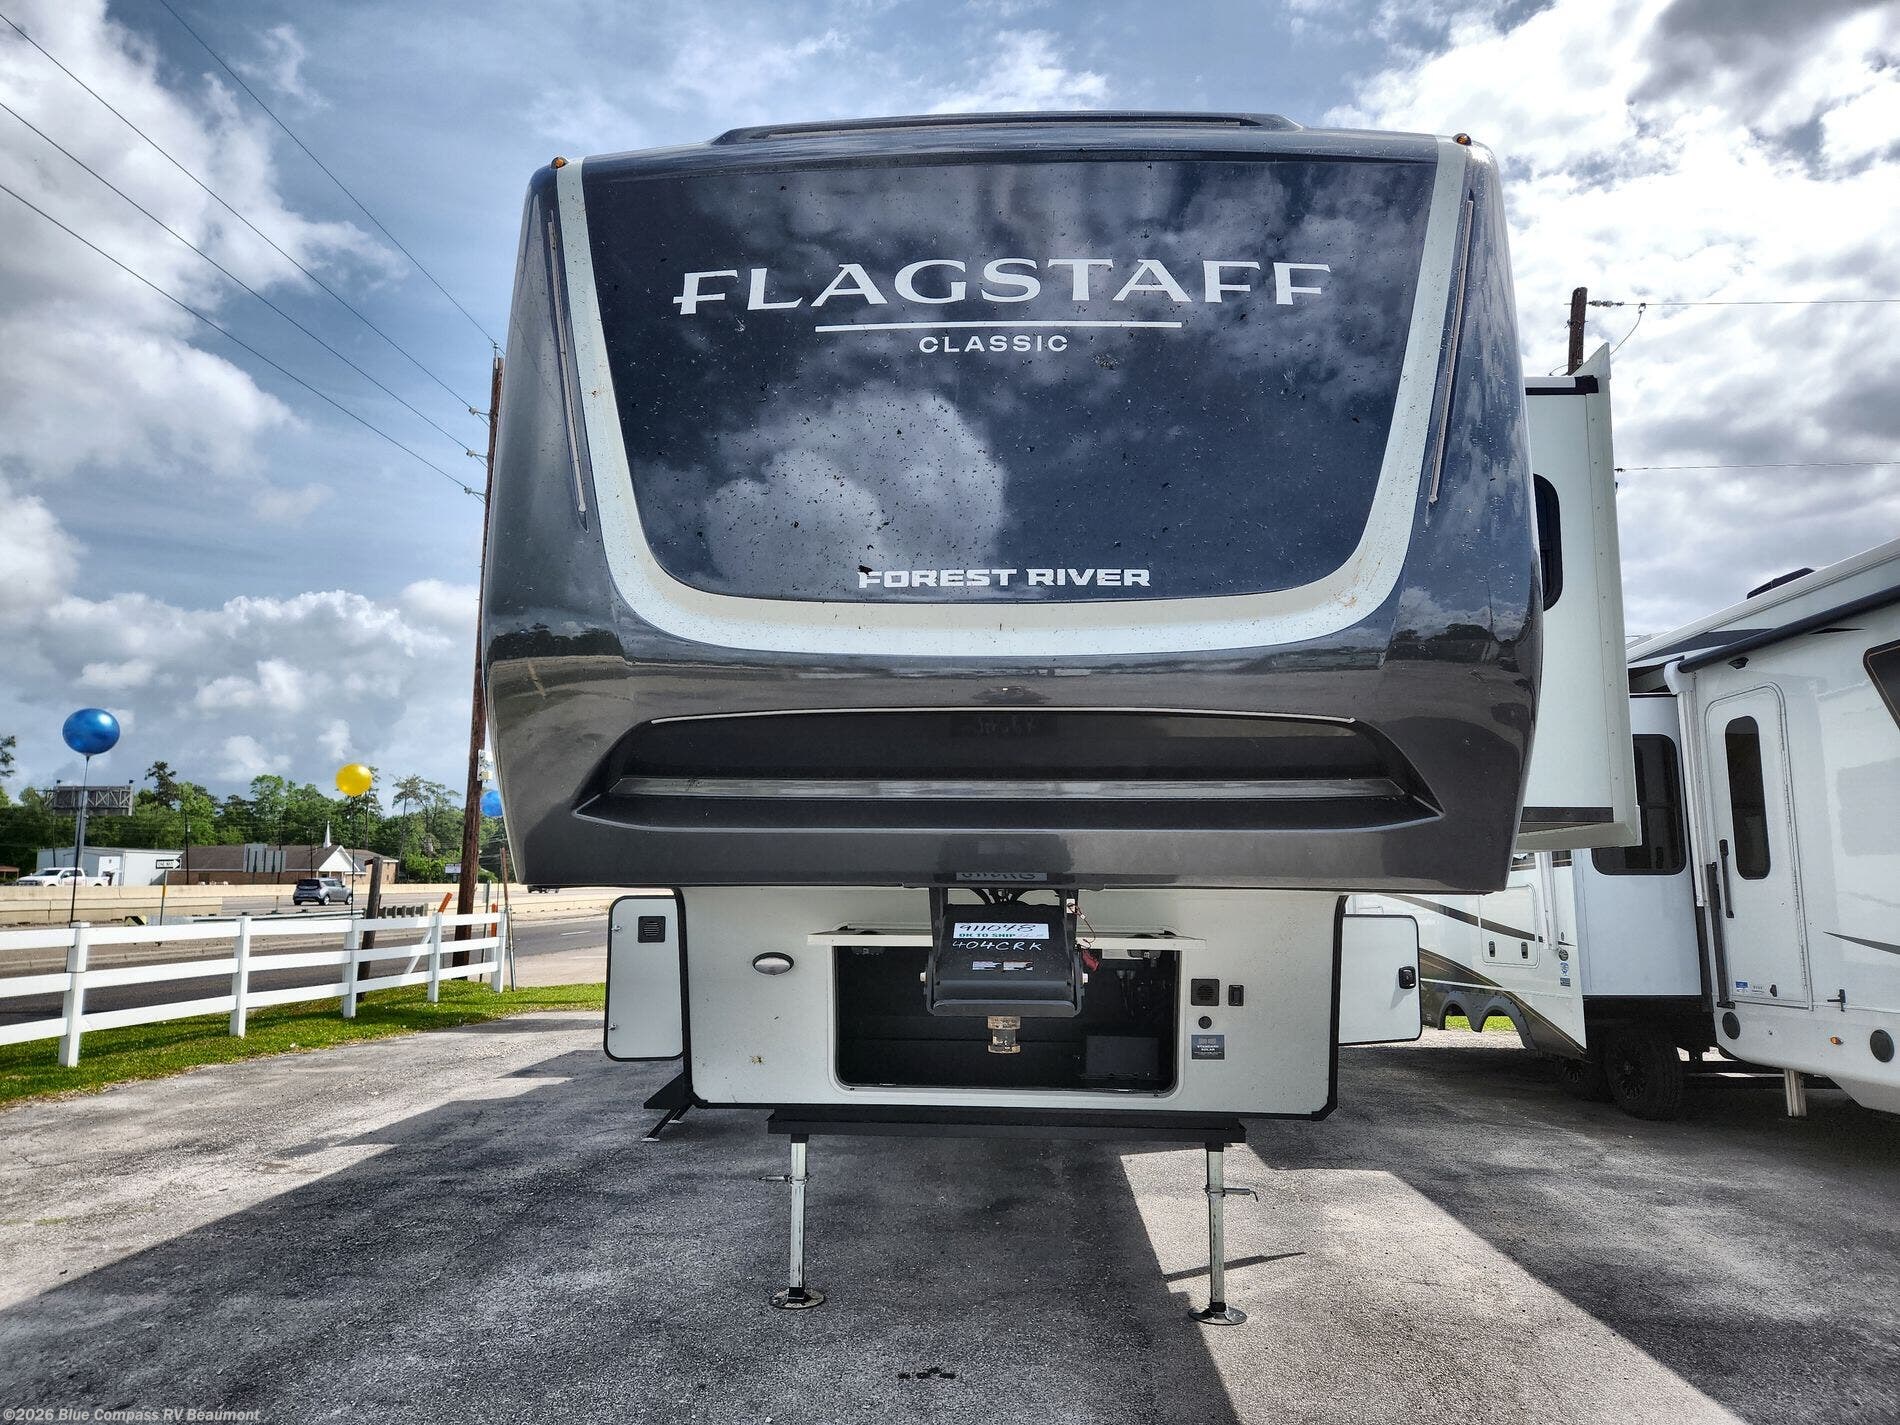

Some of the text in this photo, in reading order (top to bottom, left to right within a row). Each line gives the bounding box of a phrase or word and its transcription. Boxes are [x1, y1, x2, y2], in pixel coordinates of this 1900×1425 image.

[672, 258, 1331, 315] FLAGSTAFF
[918, 334, 1069, 353] CLASSIC
[857, 568, 1151, 588] FOREST RIVER
